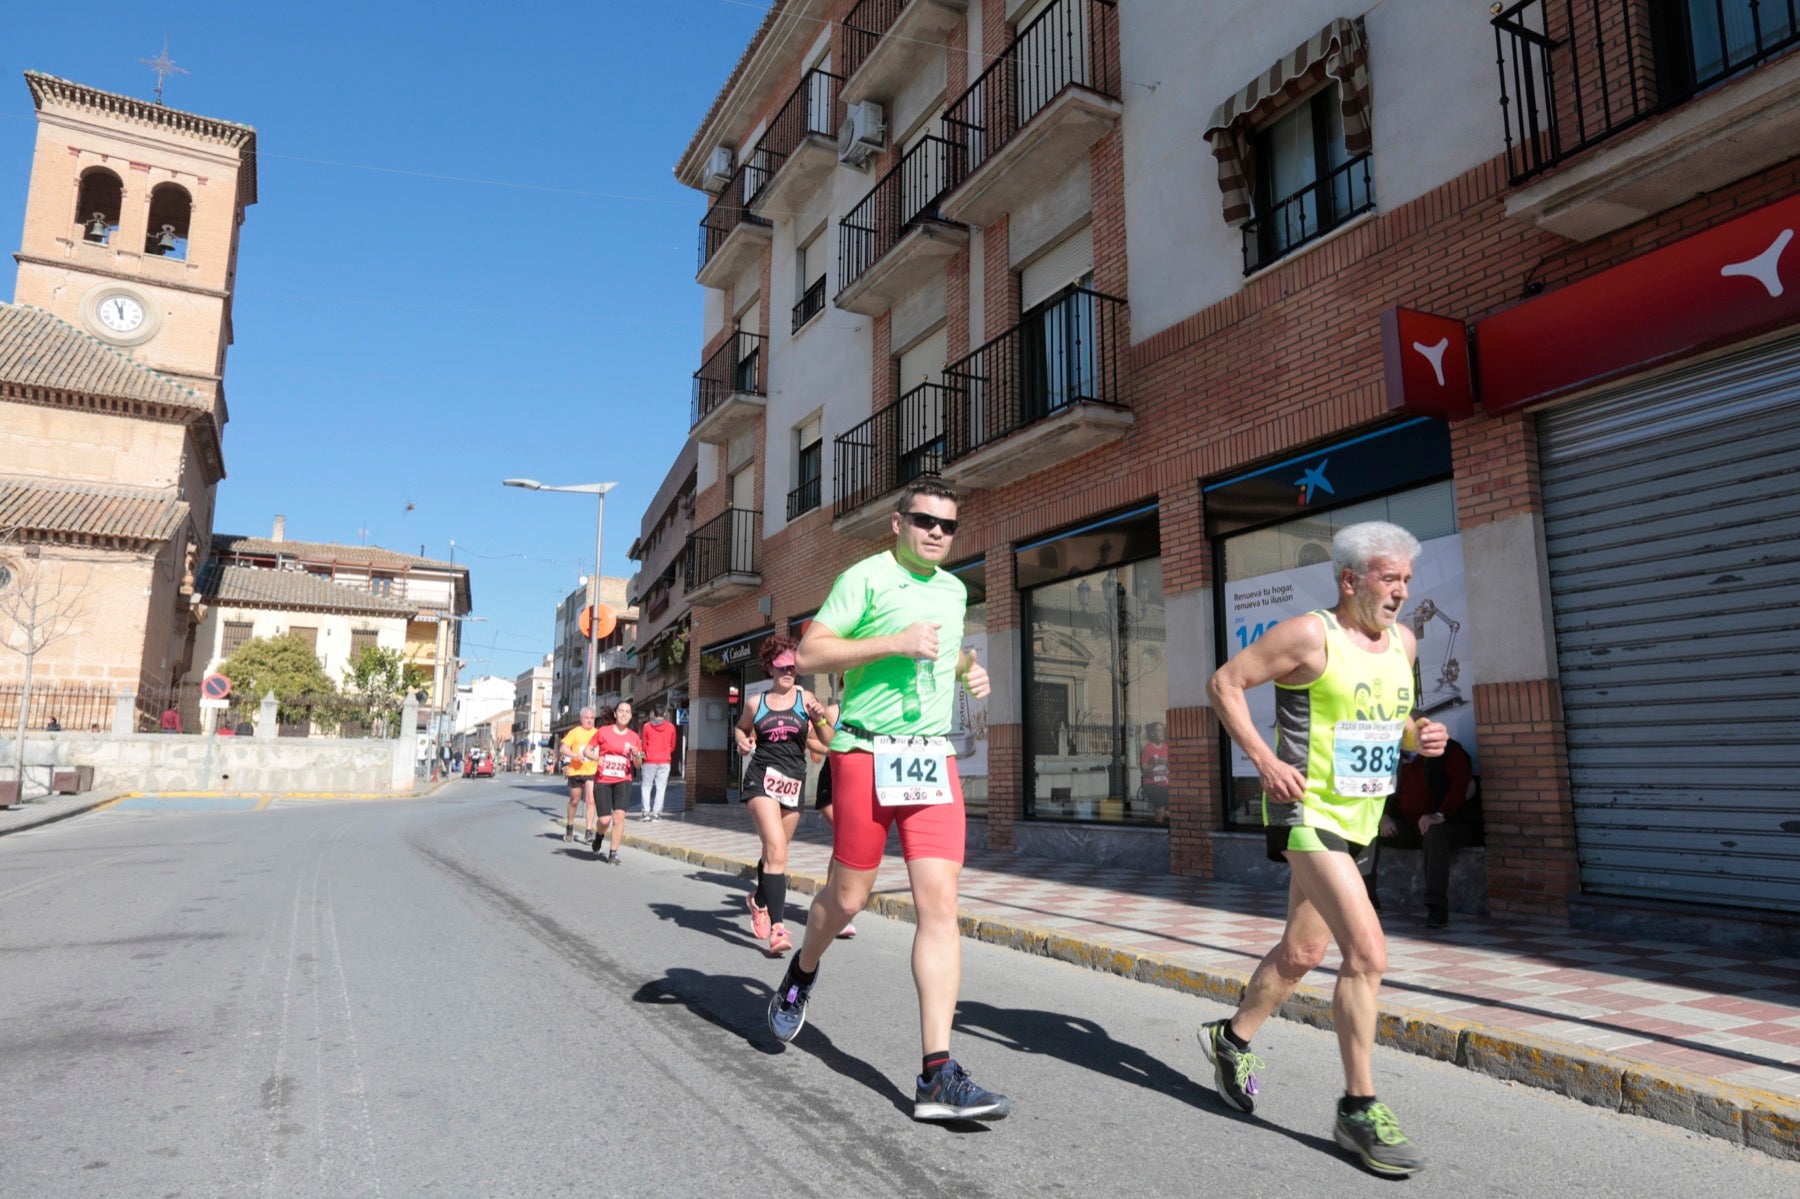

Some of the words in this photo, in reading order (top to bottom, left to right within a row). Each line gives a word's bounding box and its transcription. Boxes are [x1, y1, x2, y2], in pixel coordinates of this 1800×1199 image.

[1234, 590, 1262, 602] Renueva
[1263, 588, 1271, 596] tu
[1272, 584, 1294, 596] hogar,
[1234, 600, 1261, 611] renueva
[1262, 598, 1269, 606] tu
[890, 757, 937, 783] 142
[766, 778, 799, 795] 2203
